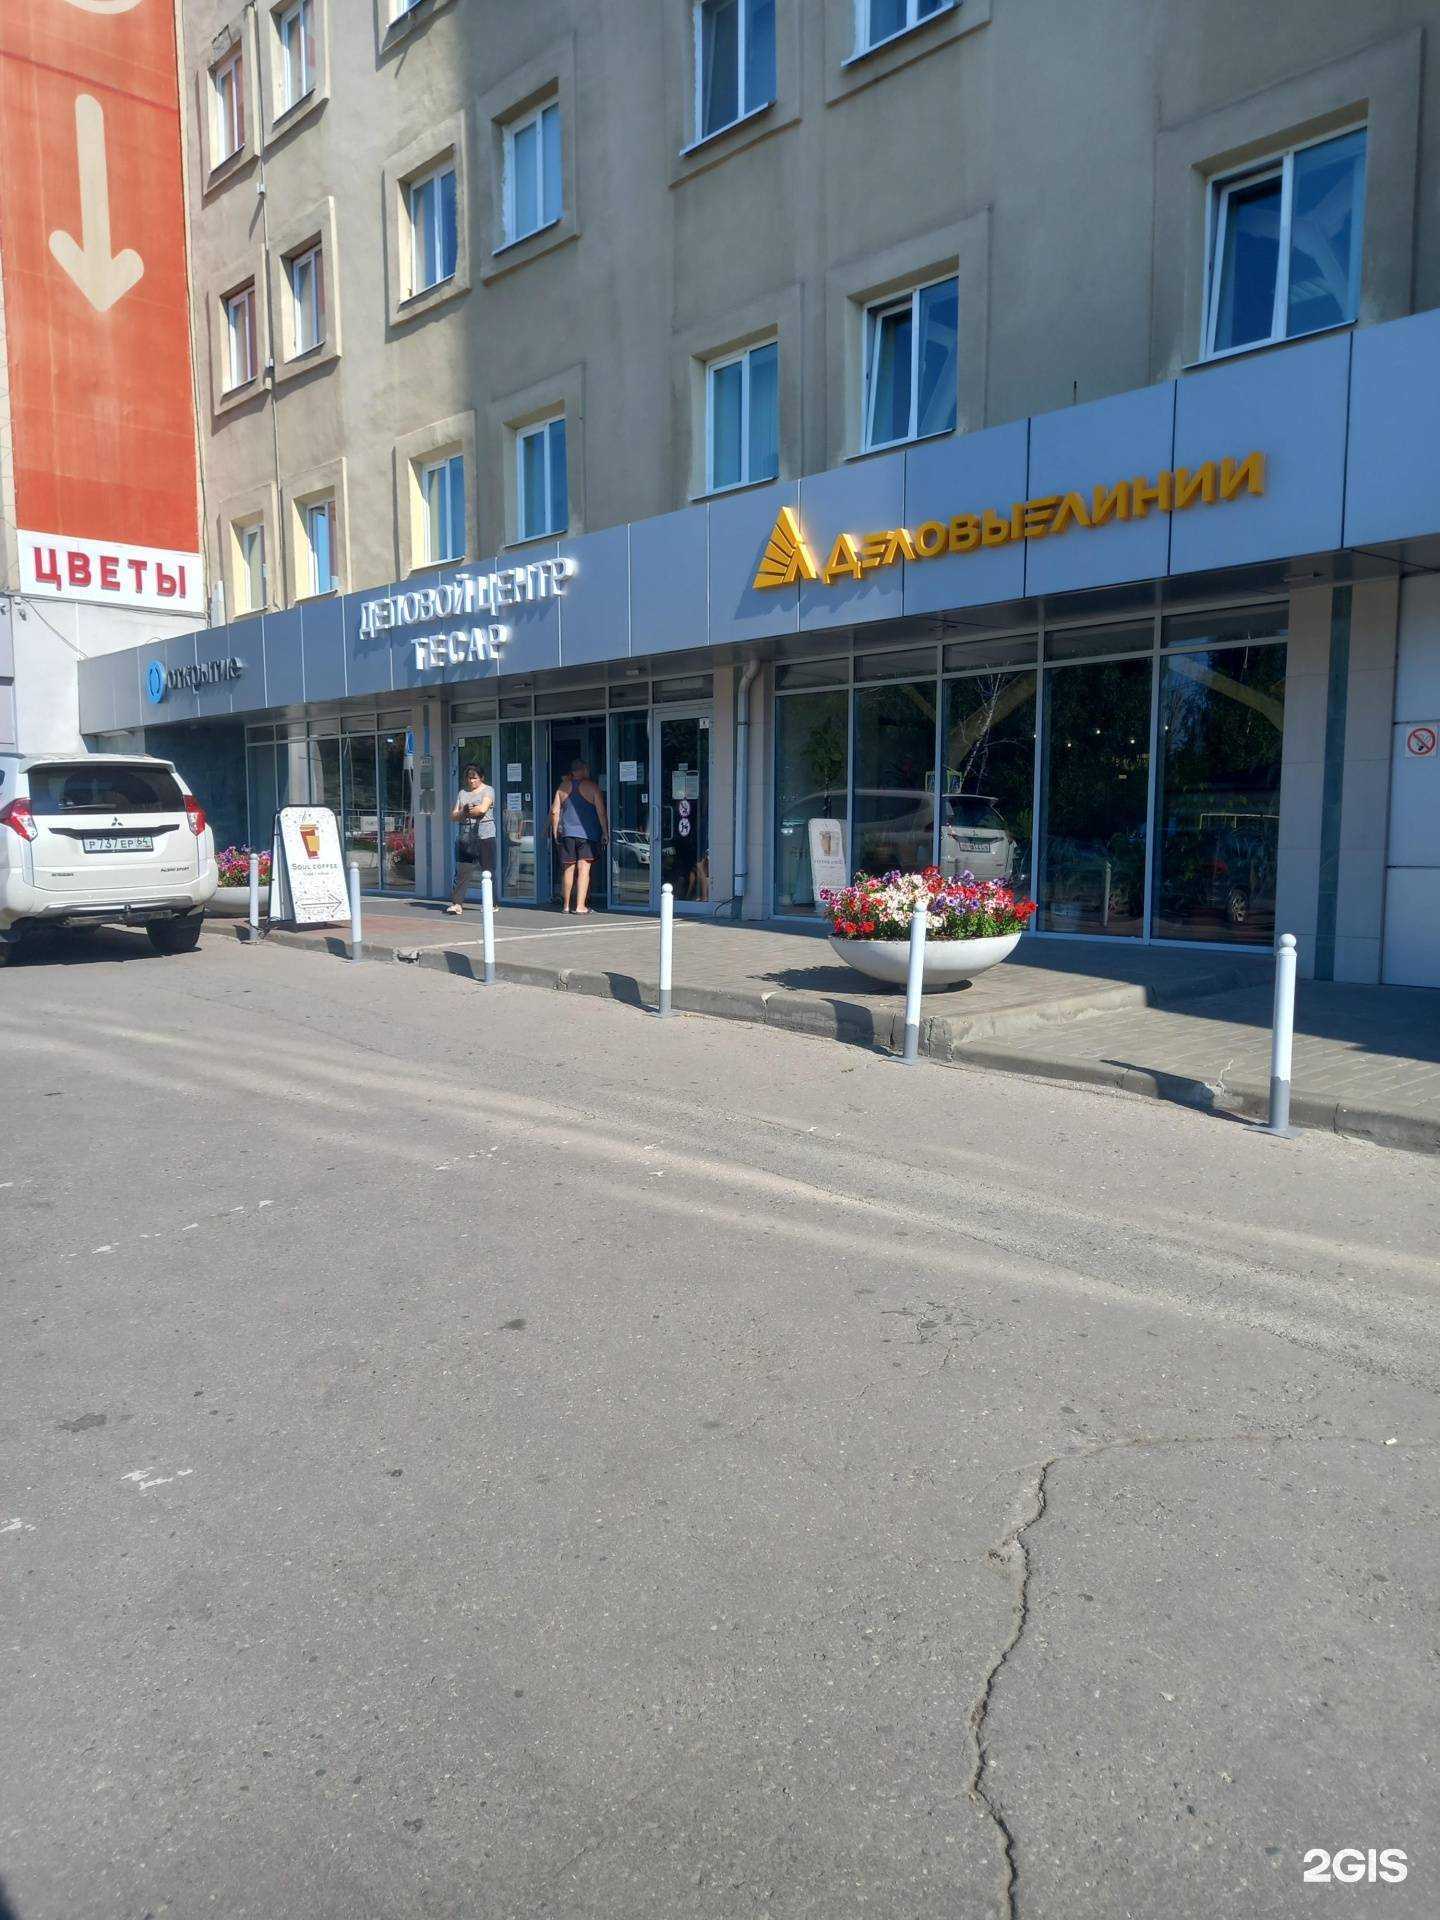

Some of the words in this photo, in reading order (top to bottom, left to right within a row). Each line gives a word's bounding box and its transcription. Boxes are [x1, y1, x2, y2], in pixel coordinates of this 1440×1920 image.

[33, 546, 186, 599] ЦВЕТЫ
[359, 573, 473, 640] ДЕЛОВОЙ
[476, 557, 578, 616] ЦЕНТР
